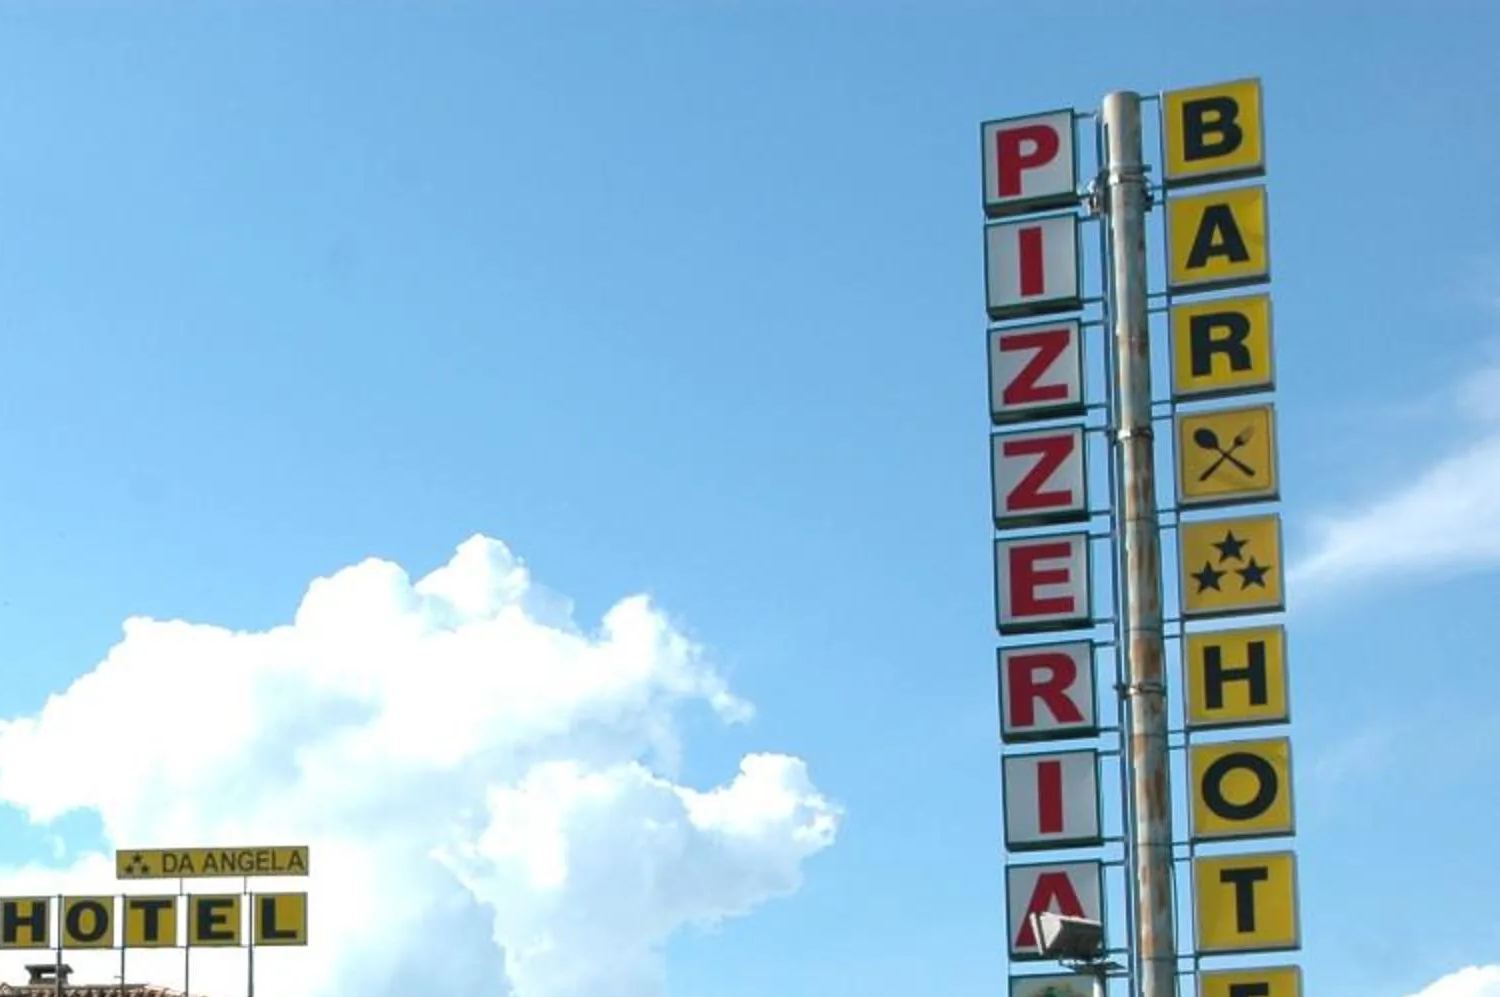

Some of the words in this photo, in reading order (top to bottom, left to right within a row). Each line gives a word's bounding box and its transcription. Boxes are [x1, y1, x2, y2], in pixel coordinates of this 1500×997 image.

[1182, 95, 1253, 378] BAR
[996, 123, 1088, 948] PIZZERIA
[3, 897, 298, 943] HOTEL
[161, 851, 195, 874] DA
[201, 849, 306, 873] ANGELA
